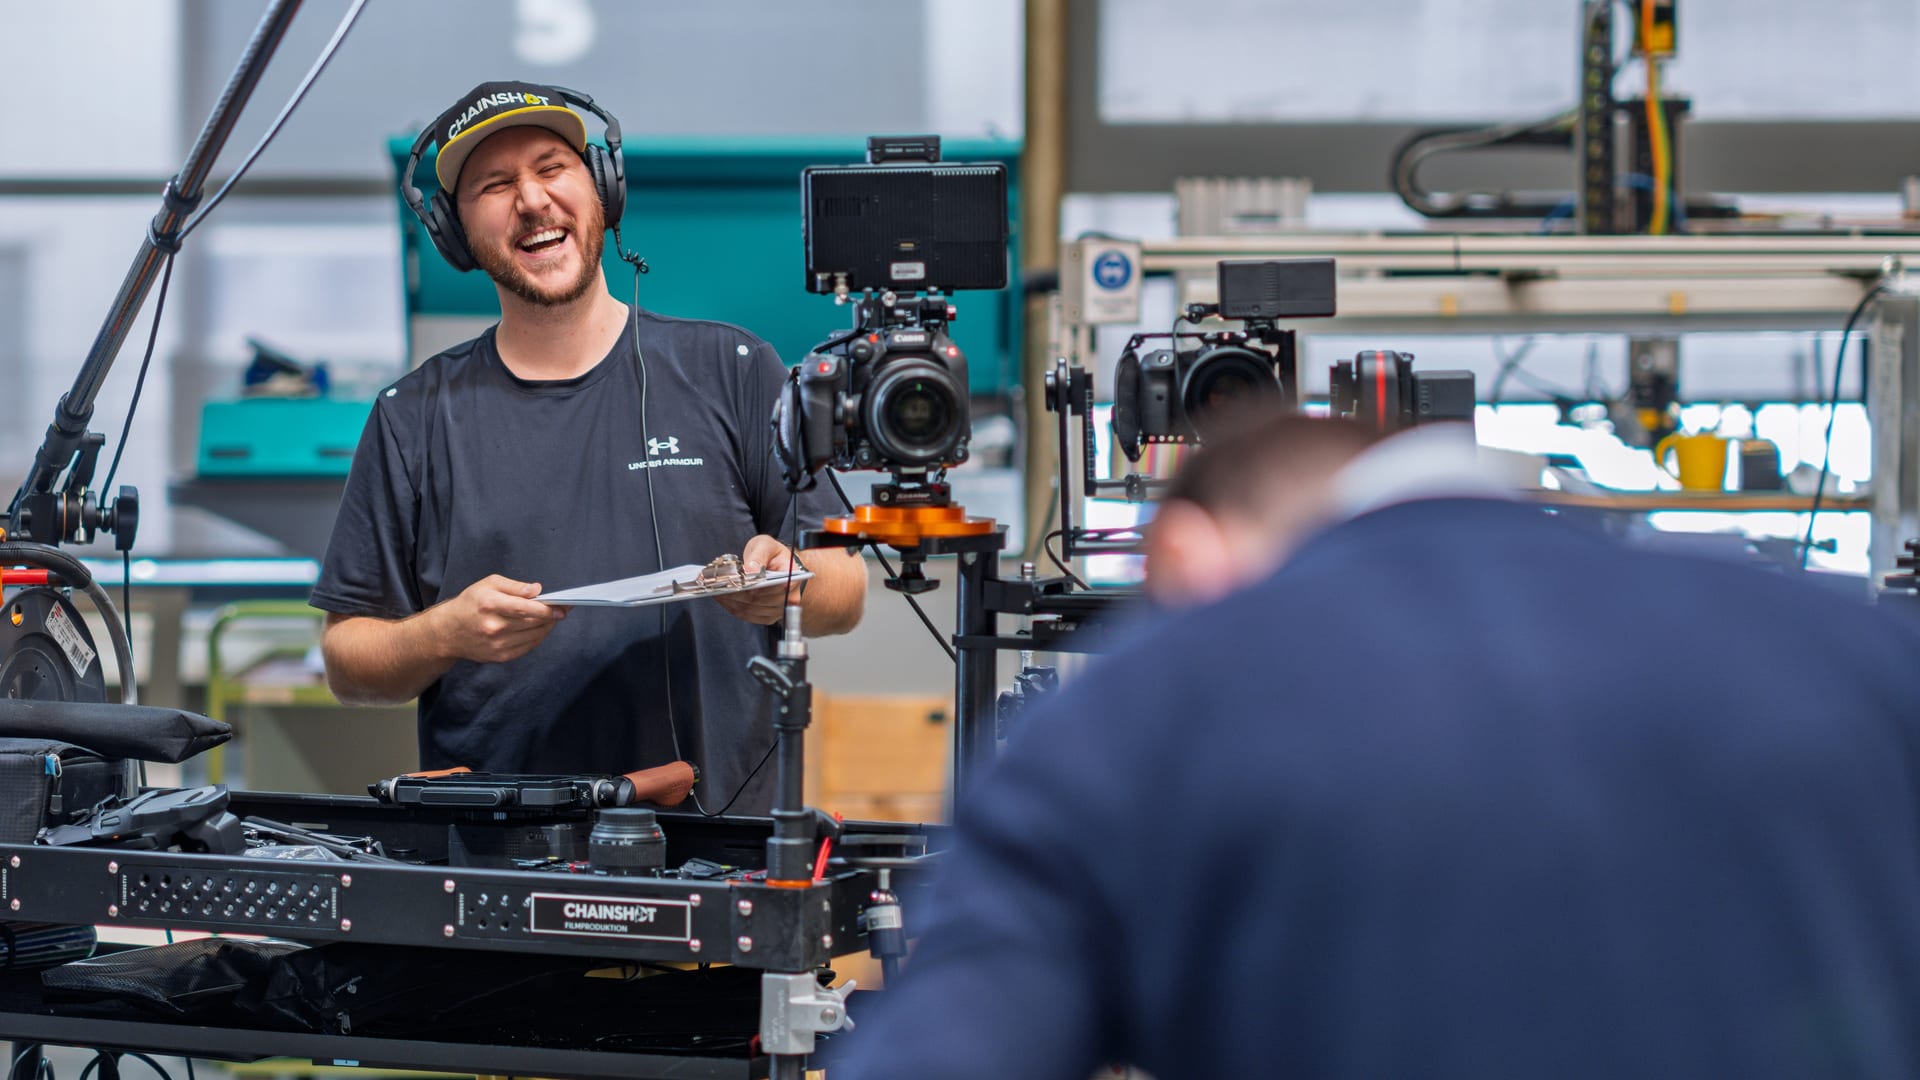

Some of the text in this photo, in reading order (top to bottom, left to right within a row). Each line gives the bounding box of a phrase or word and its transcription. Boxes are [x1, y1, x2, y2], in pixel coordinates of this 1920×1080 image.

[447, 92, 549, 140] CHAINSHOT
[628, 458, 703, 470] UNDER ARMOUR
[563, 902, 657, 923] CHAINSHOT
[564, 921, 629, 933] FILMPRODUKTION
